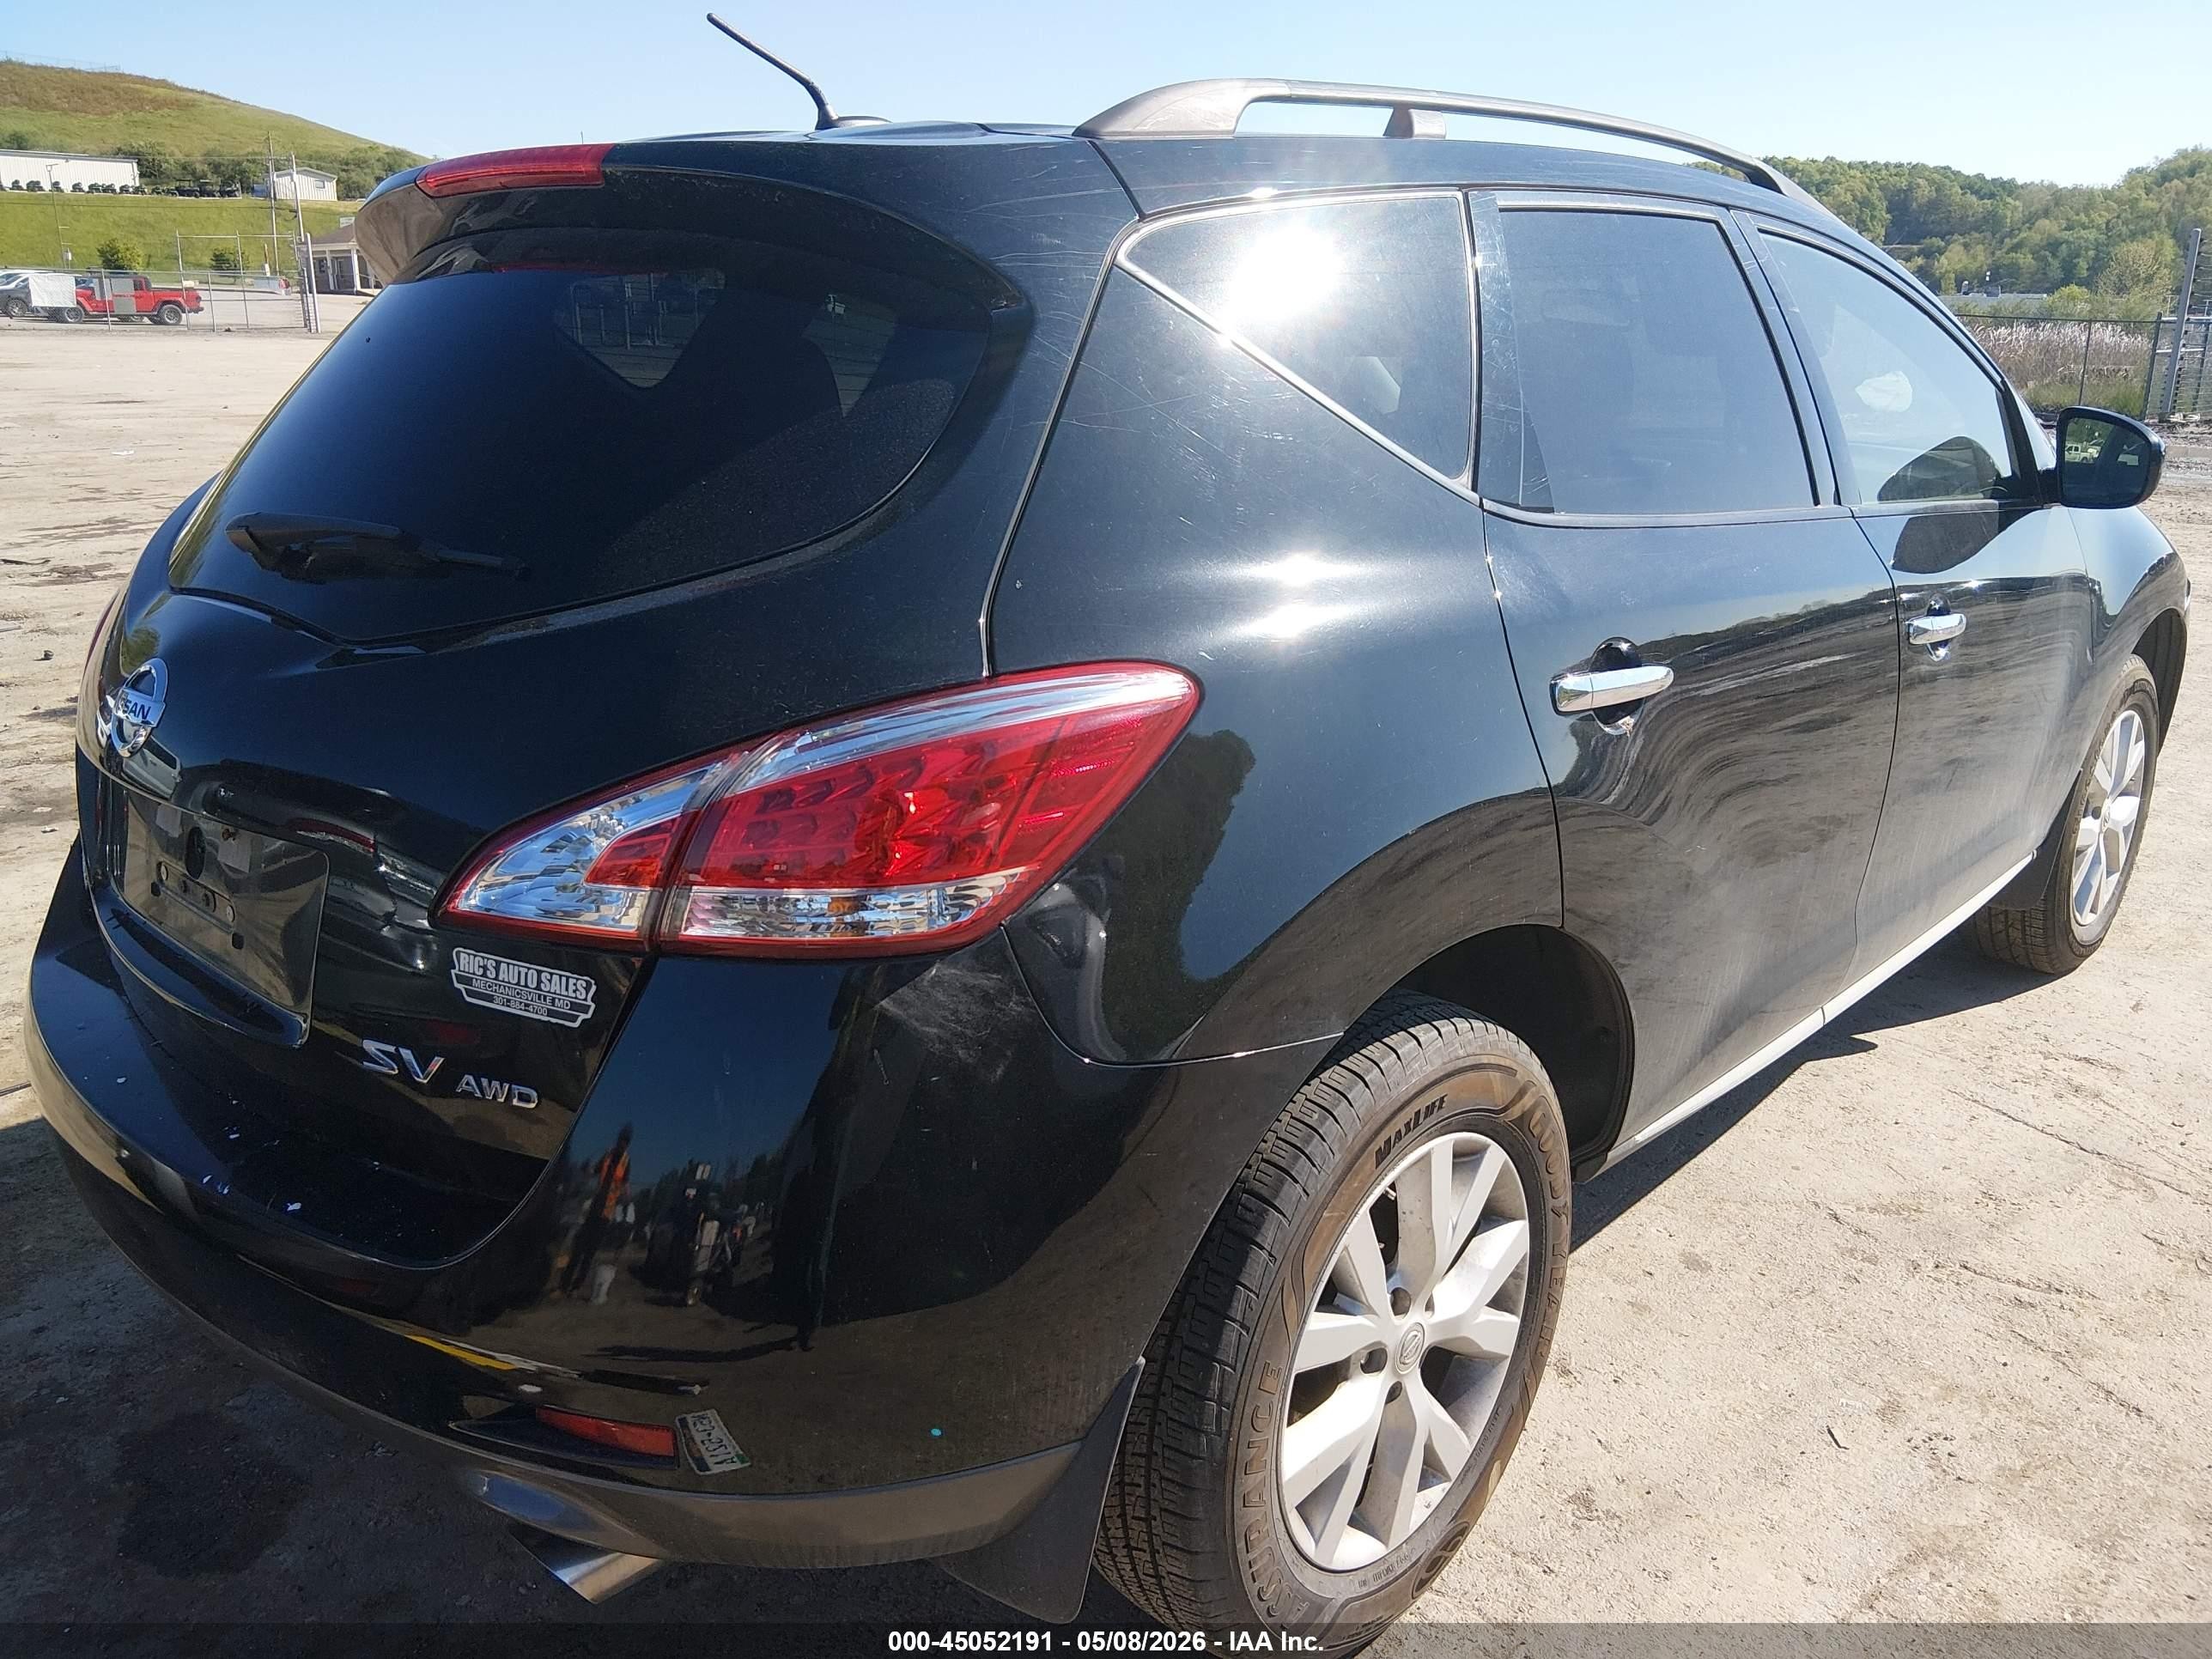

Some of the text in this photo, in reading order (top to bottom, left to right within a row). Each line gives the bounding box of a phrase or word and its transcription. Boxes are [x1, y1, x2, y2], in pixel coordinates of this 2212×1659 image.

[459, 951, 586, 1000] RIC'S AUTO SALES
[472, 978, 571, 1011] MECHANICSVILLE MD
[493, 995, 548, 1016] 301-884-4700
[362, 1039, 538, 1109] SV AWD
[1243, 1359, 1310, 1632] ASSURANCE
